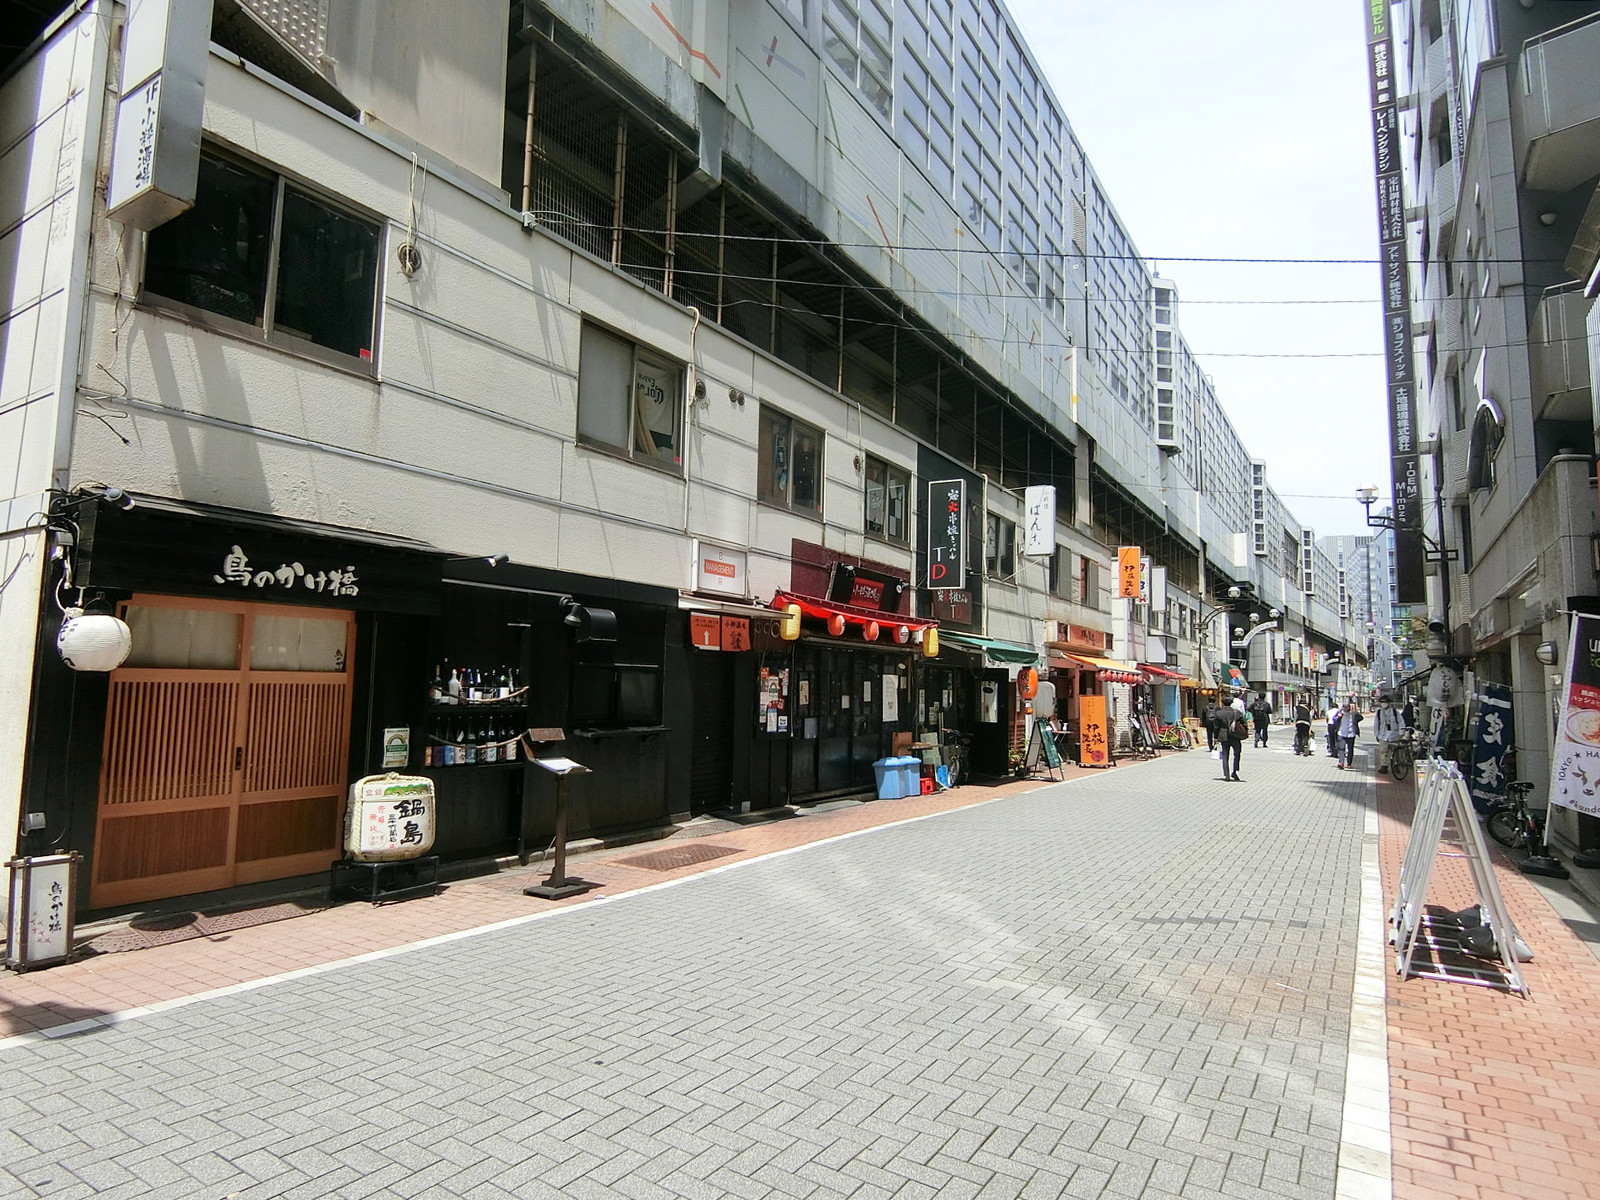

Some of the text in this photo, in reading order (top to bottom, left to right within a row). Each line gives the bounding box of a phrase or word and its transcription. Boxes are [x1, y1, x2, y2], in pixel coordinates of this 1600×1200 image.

[213, 544, 360, 597] 鳥のかけ橋
[1558, 757, 1573, 782] TOKYO
[393, 799, 425, 846] 鍋島
[48, 881, 63, 933] 鳥のかけ橋
